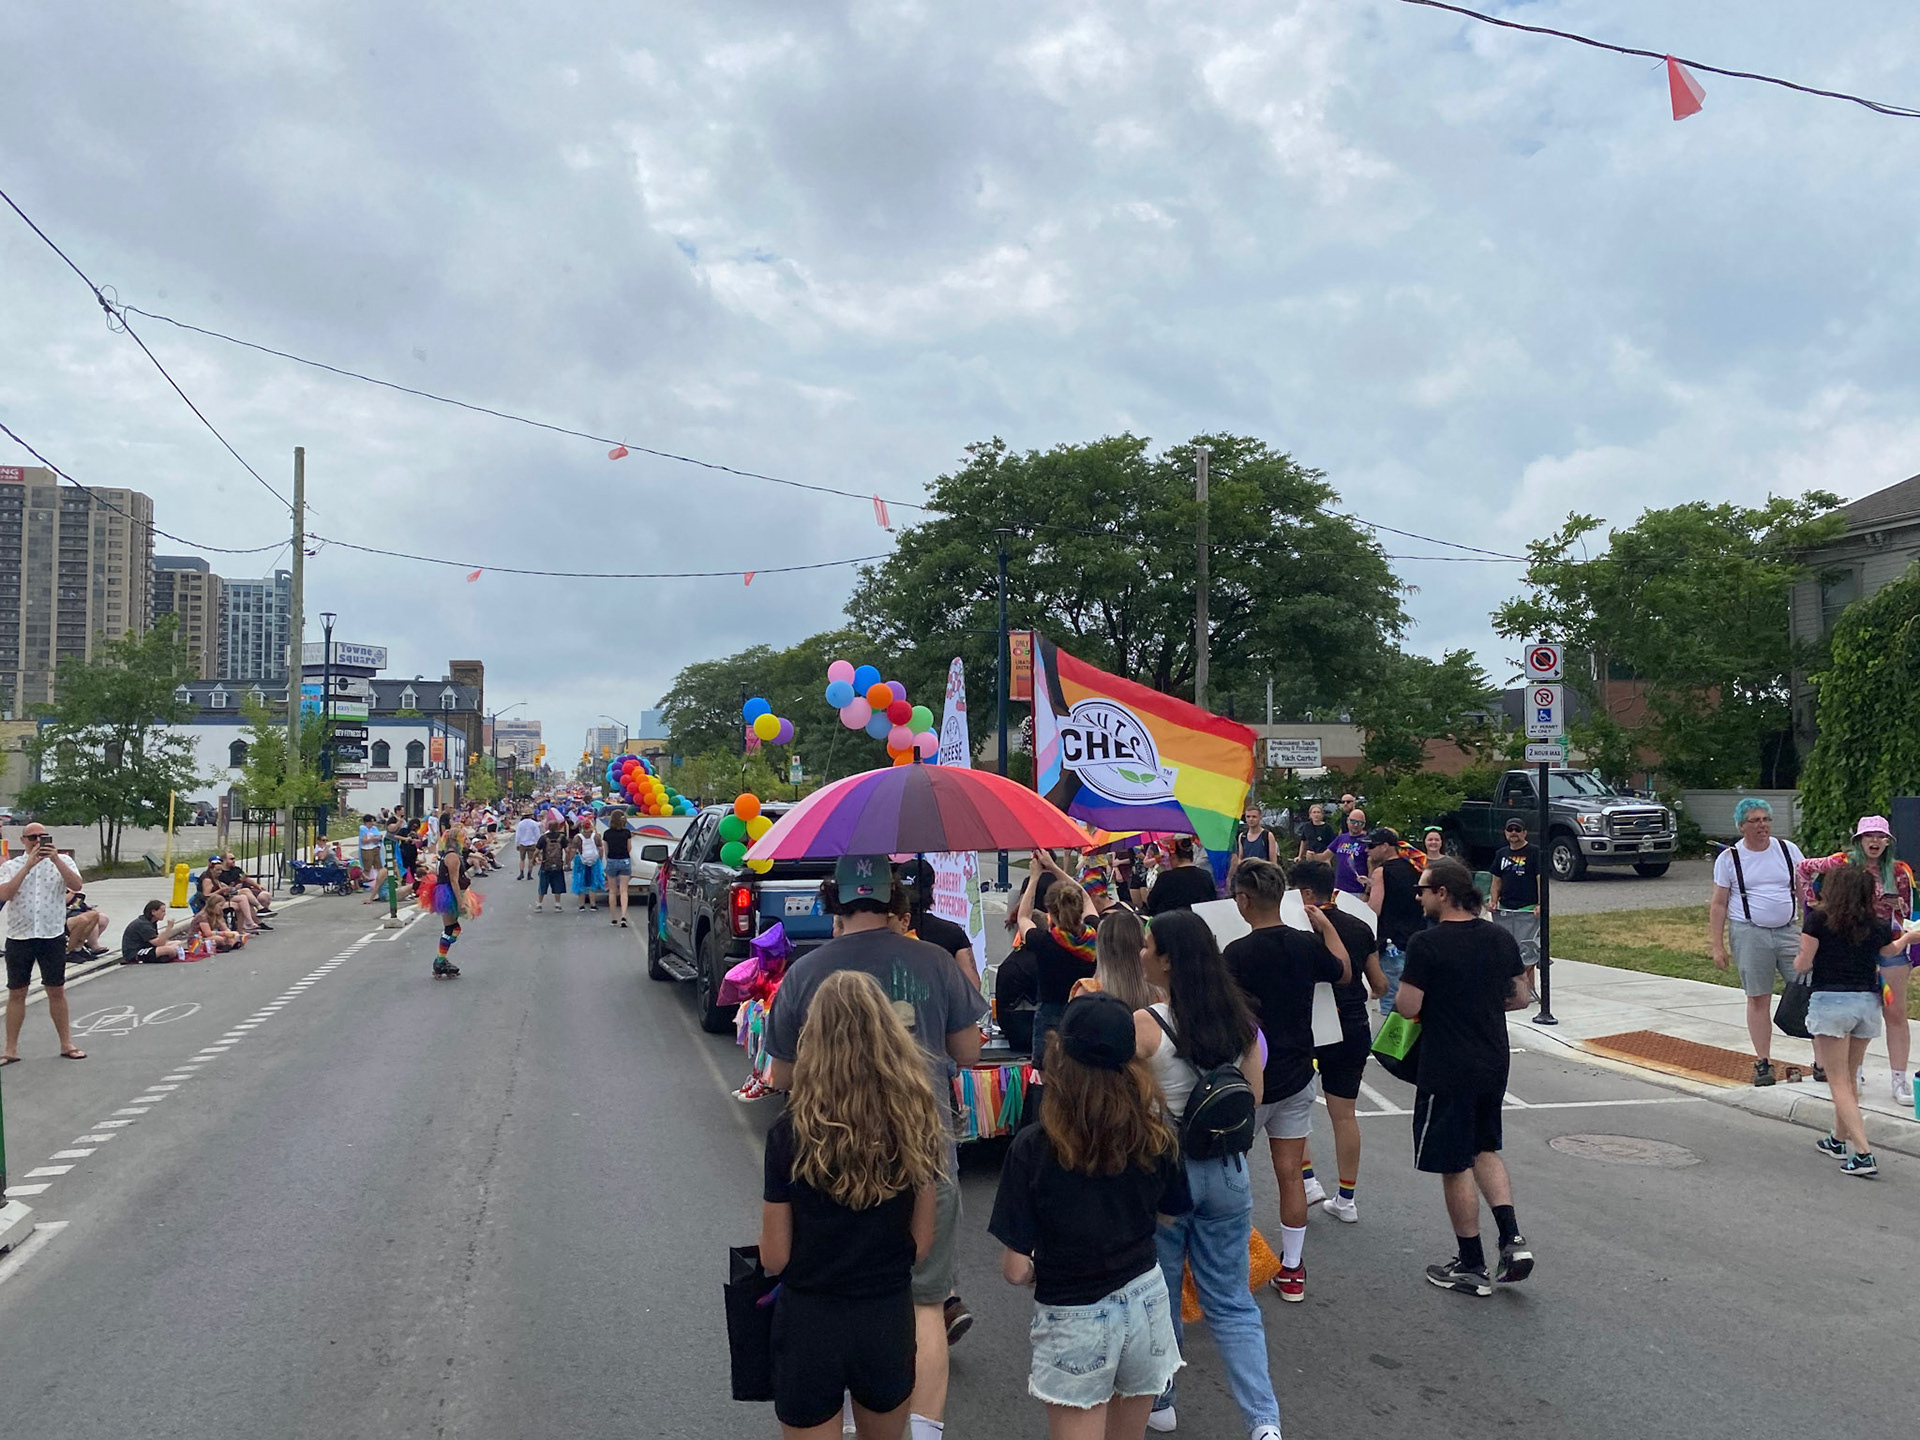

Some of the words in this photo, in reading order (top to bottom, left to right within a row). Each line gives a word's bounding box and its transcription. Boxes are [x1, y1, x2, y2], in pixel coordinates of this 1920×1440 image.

[340, 642, 373, 656] Towne
[339, 653, 377, 665] Square
[940, 741, 963, 765] CHEESE
[1529, 748, 1533, 756] 2
[1163, 768, 1173, 776] TM
